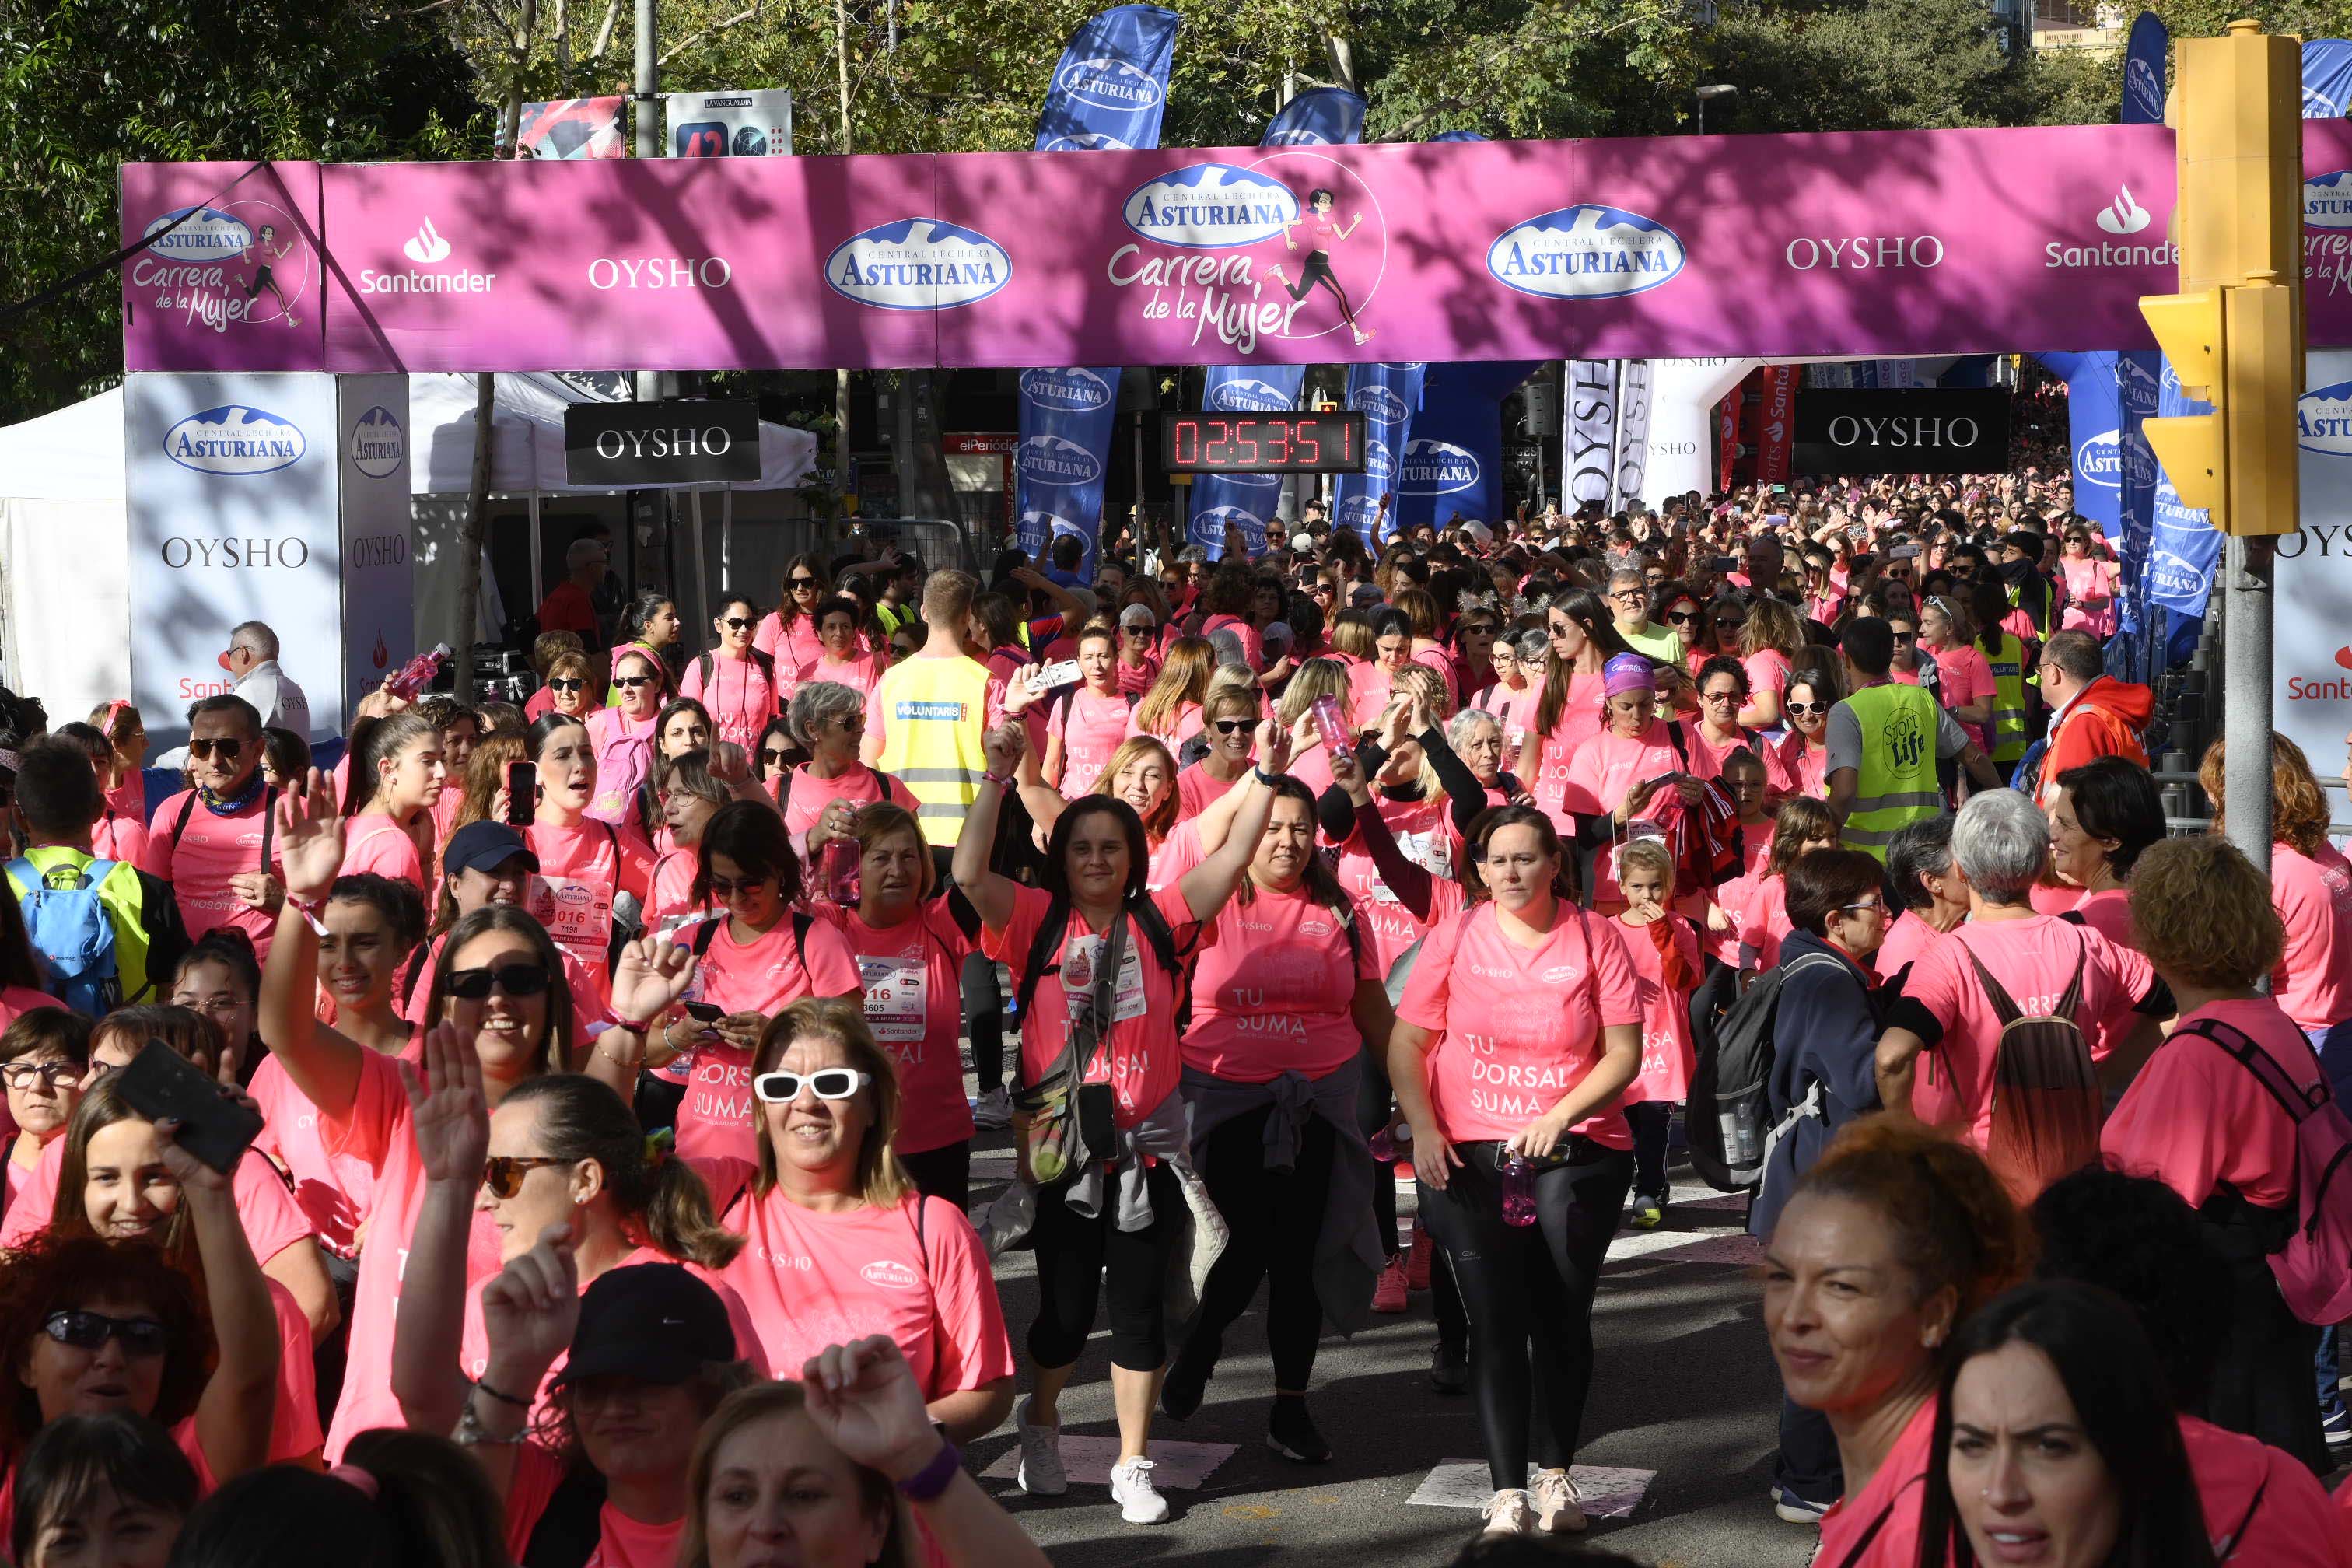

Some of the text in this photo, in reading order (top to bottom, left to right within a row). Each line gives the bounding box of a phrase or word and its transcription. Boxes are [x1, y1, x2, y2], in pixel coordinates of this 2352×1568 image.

[1066, 71, 1152, 103] ASTURIANA
[1163, 191, 1281, 201] CENTRAL LECHERA
[1136, 194, 1285, 226] ASTURIANA
[152, 226, 243, 247] ASTURIANA
[1533, 236, 1664, 247] CENTRAL LECHERA
[868, 249, 990, 259] CENTRAL LECHERA
[1108, 243, 1253, 286] Carrera
[1502, 241, 1669, 275] ASTURIANA
[1786, 236, 1944, 270] OYSHO
[133, 258, 223, 287] Carrera
[360, 269, 495, 293] Santander
[588, 257, 731, 289] OYSHO
[839, 252, 996, 286] ASTURIANA
[2319, 257, 2331, 278] la
[156, 285, 259, 333] de la Mujer
[1143, 281, 1307, 354] de la Mujer
[1027, 374, 1101, 404] ASTURIANA
[175, 432, 295, 457] ASTURIANA
[596, 426, 730, 459] OYSHO
[1829, 415, 1979, 447] OYSHO
[355, 434, 401, 460] ASTURIANA
[1022, 449, 1091, 477] ASTURIANA
[162, 537, 308, 569] OYSHO
[354, 534, 404, 569] OYSHO
[782, 666, 795, 677] TU
[897, 705, 959, 716] VOLUNTARIS
[1885, 713, 1918, 745] Sport
[1073, 747, 1087, 759] TU
[1549, 746, 1563, 760] TU
[1892, 731, 1924, 768] Life
[1472, 964, 1513, 978] OYSHO
[865, 989, 891, 1000] 16
[1233, 989, 1263, 1006] TU
[1236, 1013, 1306, 1035] SUMA
[1465, 1033, 1494, 1055] TU
[1472, 1059, 1568, 1089] DORSAL
[1471, 1089, 1543, 1115] SUMA
[866, 1268, 914, 1284] ASTURIANA
